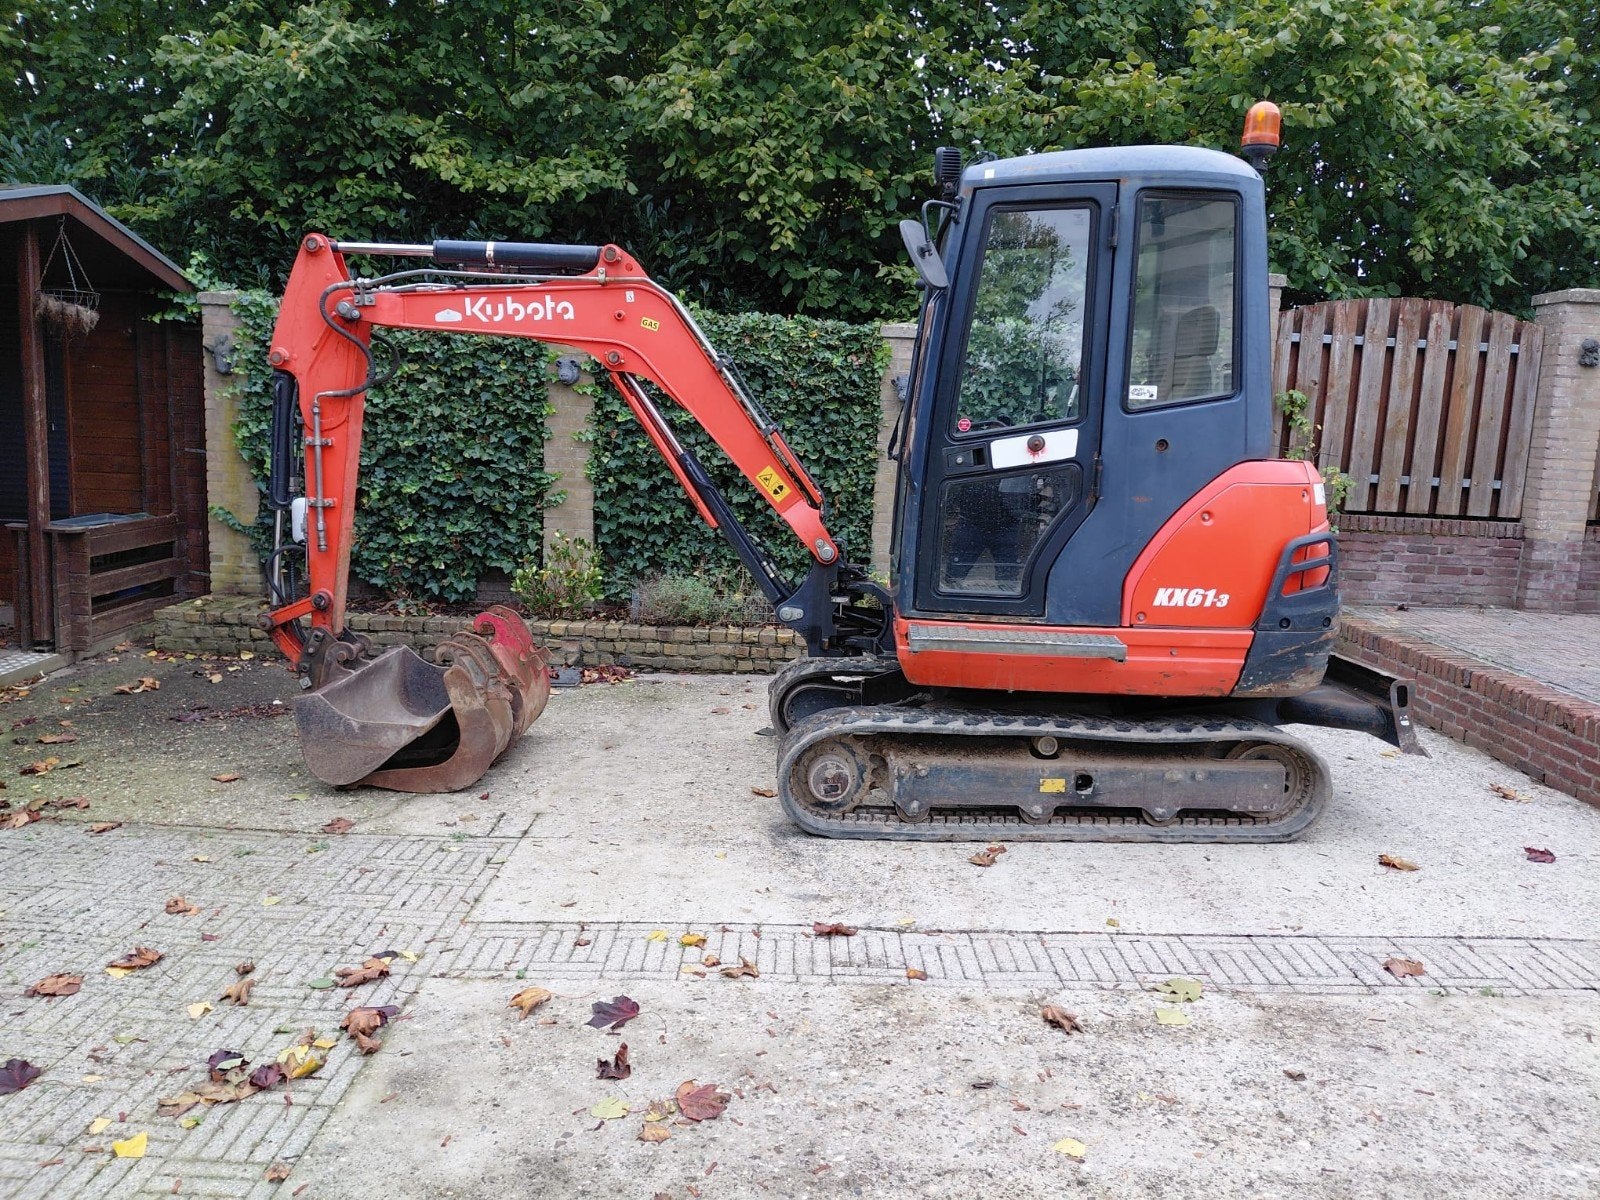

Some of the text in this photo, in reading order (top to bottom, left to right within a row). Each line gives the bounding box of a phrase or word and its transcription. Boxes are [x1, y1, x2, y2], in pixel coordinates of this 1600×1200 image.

[464, 294, 575, 322] Kubota
[641, 319, 658, 330] GAS
[1152, 587, 1230, 608] KX61-3
